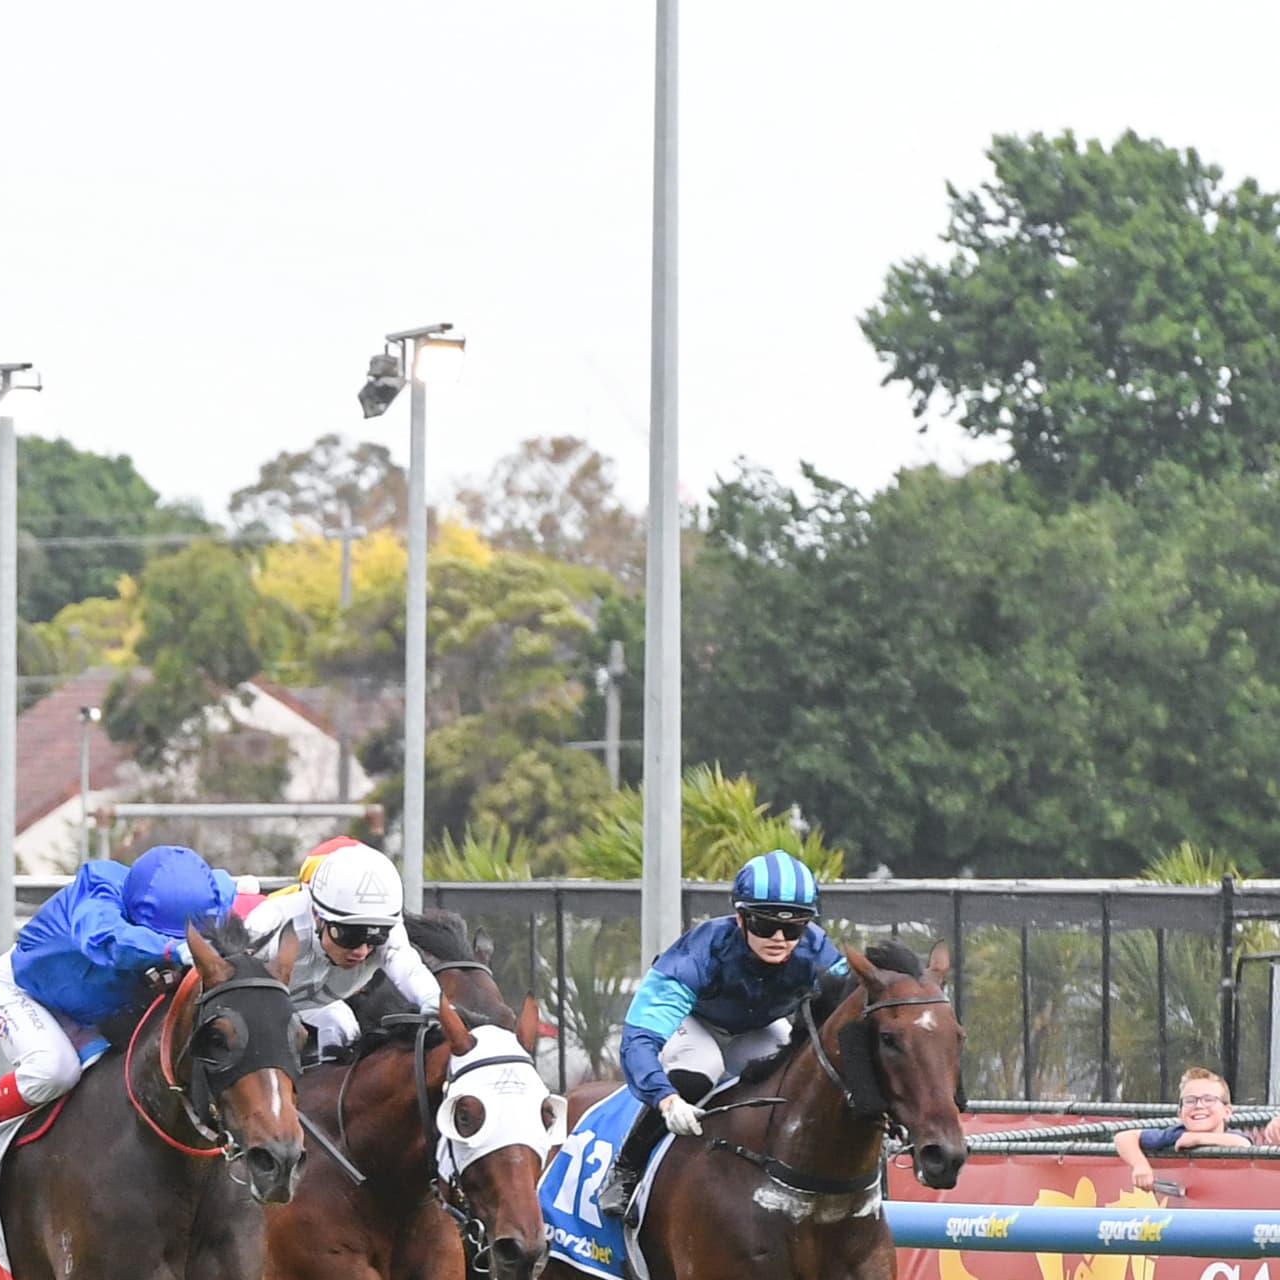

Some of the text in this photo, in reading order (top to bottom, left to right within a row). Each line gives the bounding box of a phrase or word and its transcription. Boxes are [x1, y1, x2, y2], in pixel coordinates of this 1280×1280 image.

[553, 1129, 614, 1229] 12
[544, 1223, 612, 1264] portsbet
[946, 1212, 1010, 1243] sportsbet
[1098, 1216, 1164, 1246] sportsbet
